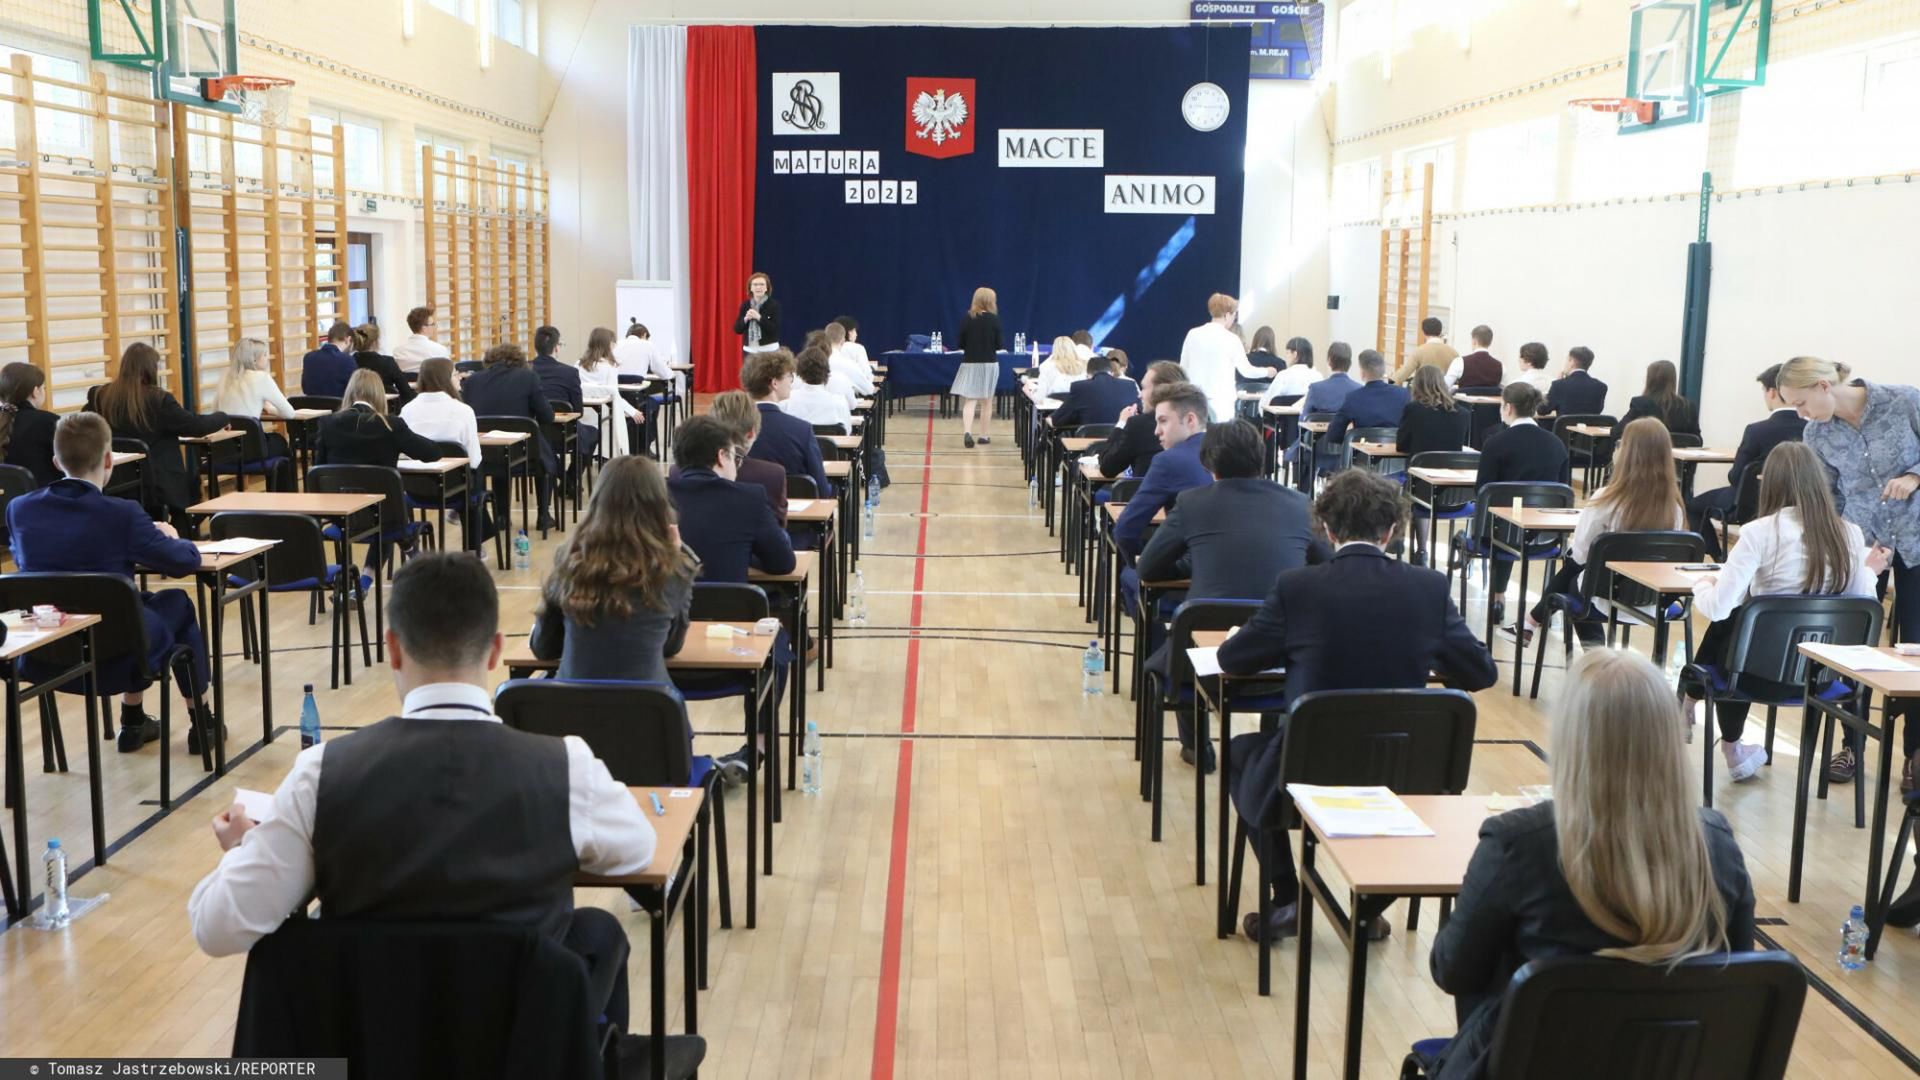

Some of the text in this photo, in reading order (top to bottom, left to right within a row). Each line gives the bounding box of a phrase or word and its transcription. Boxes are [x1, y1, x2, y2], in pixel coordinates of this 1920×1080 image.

[1195, 4, 1256, 14] GOSPODARZE
[1271, 4, 1310, 15] GOŚCIE
[1006, 137, 1096, 159] MACTE
[775, 158, 876, 170] MATURA
[849, 187, 913, 200] 2022
[1111, 183, 1205, 205] ANIMO
